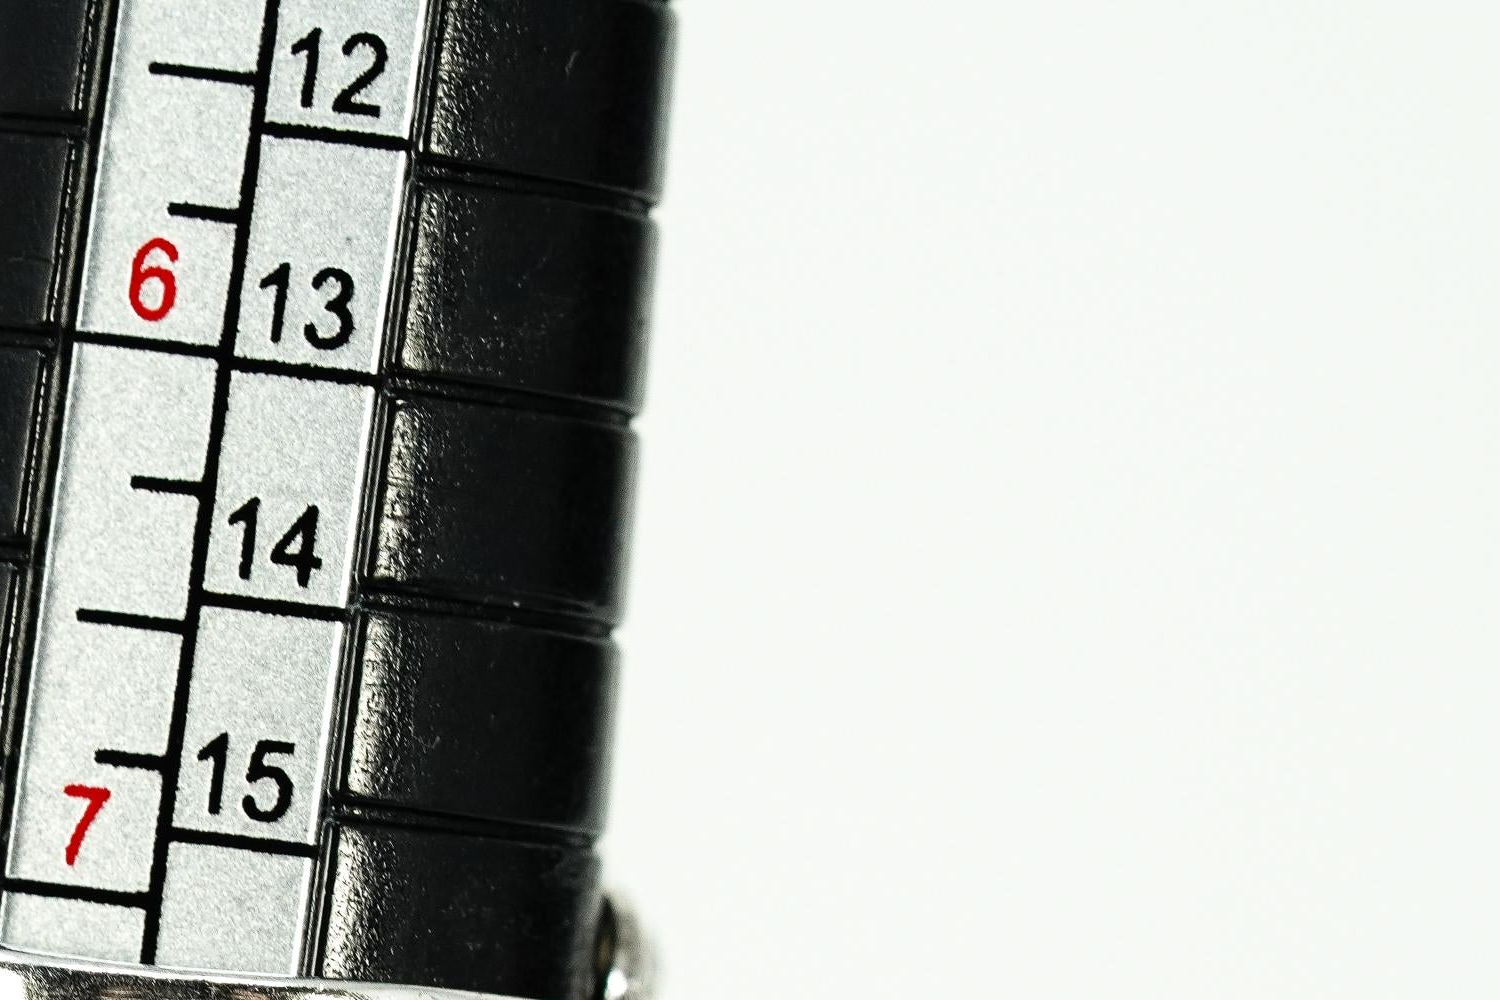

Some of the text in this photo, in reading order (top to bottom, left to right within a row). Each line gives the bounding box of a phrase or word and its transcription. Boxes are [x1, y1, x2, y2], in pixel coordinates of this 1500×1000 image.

[291, 27, 388, 118] 12
[129, 238, 178, 321] 6
[259, 263, 356, 350] 13
[228, 497, 322, 588] 14
[197, 732, 295, 823] 15
[64, 785, 110, 865] 7
